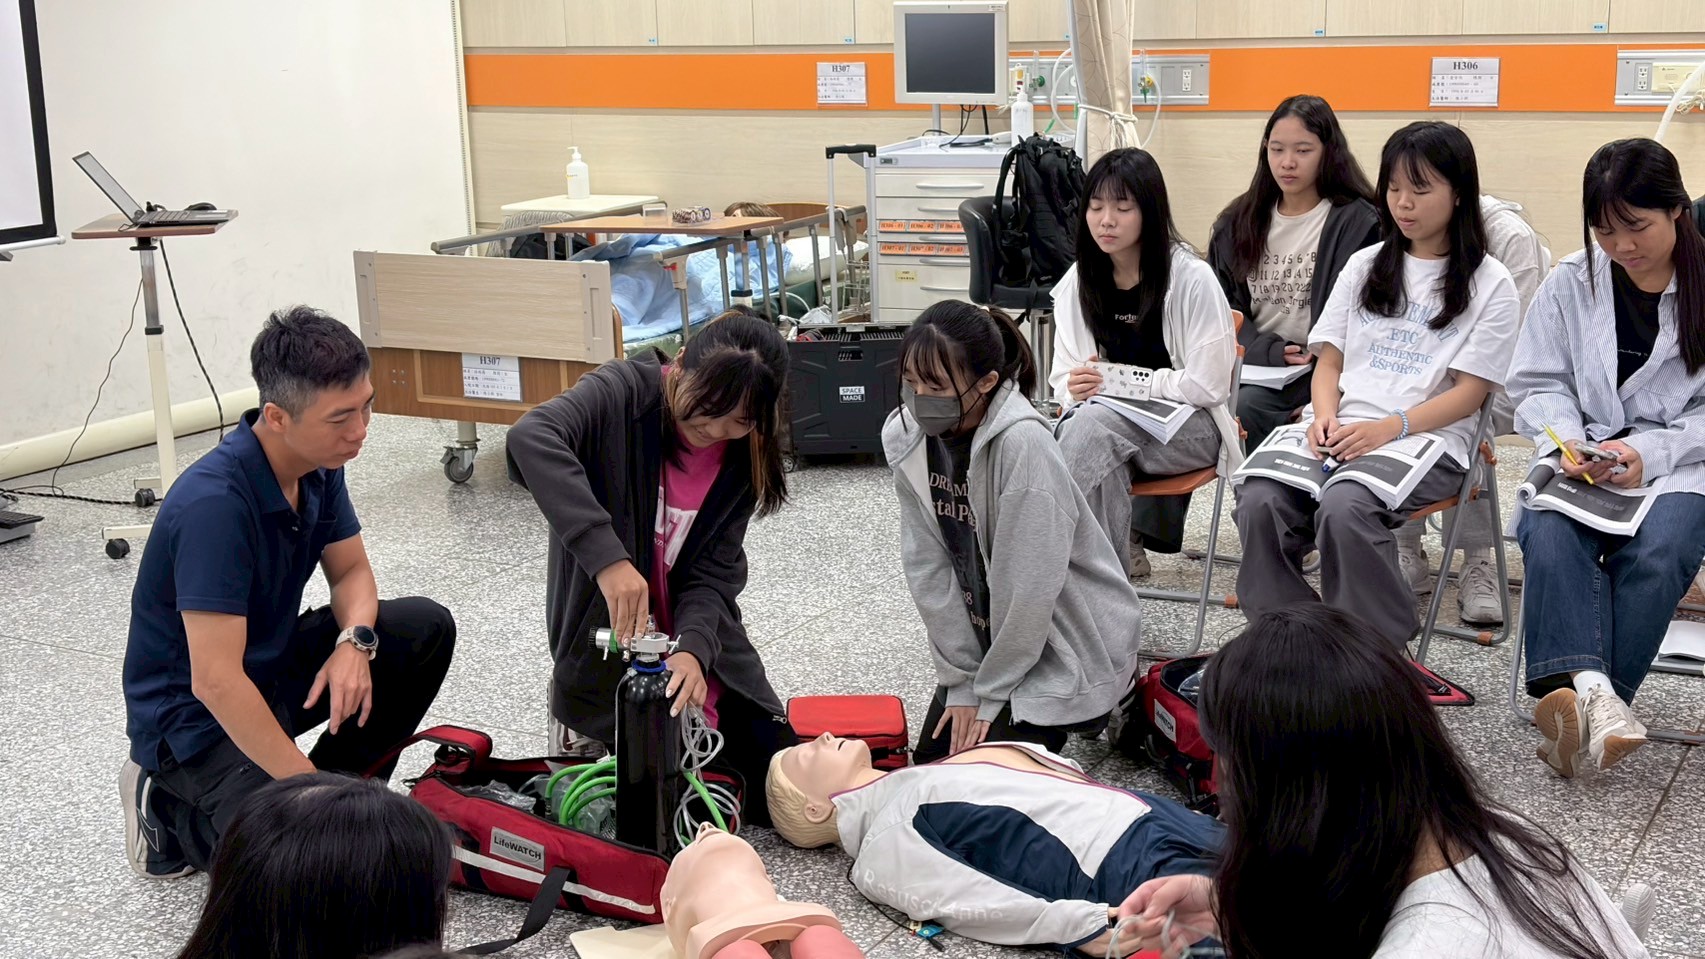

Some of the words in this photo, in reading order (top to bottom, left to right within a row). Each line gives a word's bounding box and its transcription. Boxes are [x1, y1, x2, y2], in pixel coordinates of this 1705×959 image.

[831, 64, 851, 73] H307
[1453, 61, 1479, 71] H306
[1263, 254, 1270, 265] 2
[1273, 254, 1279, 265] 3
[1287, 253, 1293, 264] 5
[1297, 253, 1303, 264] 6
[1260, 269, 1268, 280] 11
[1271, 270, 1280, 281] 12
[1283, 268, 1292, 278] 13
[1304, 267, 1313, 279] 15
[1259, 285, 1270, 294] 18
[1281, 282, 1293, 292] 20
[1367, 342, 1434, 365] AUTHENTIC
[479, 355, 501, 366] H307
[1369, 352, 1423, 376] &SPORTS
[493, 835, 542, 860] LifeWATCH
